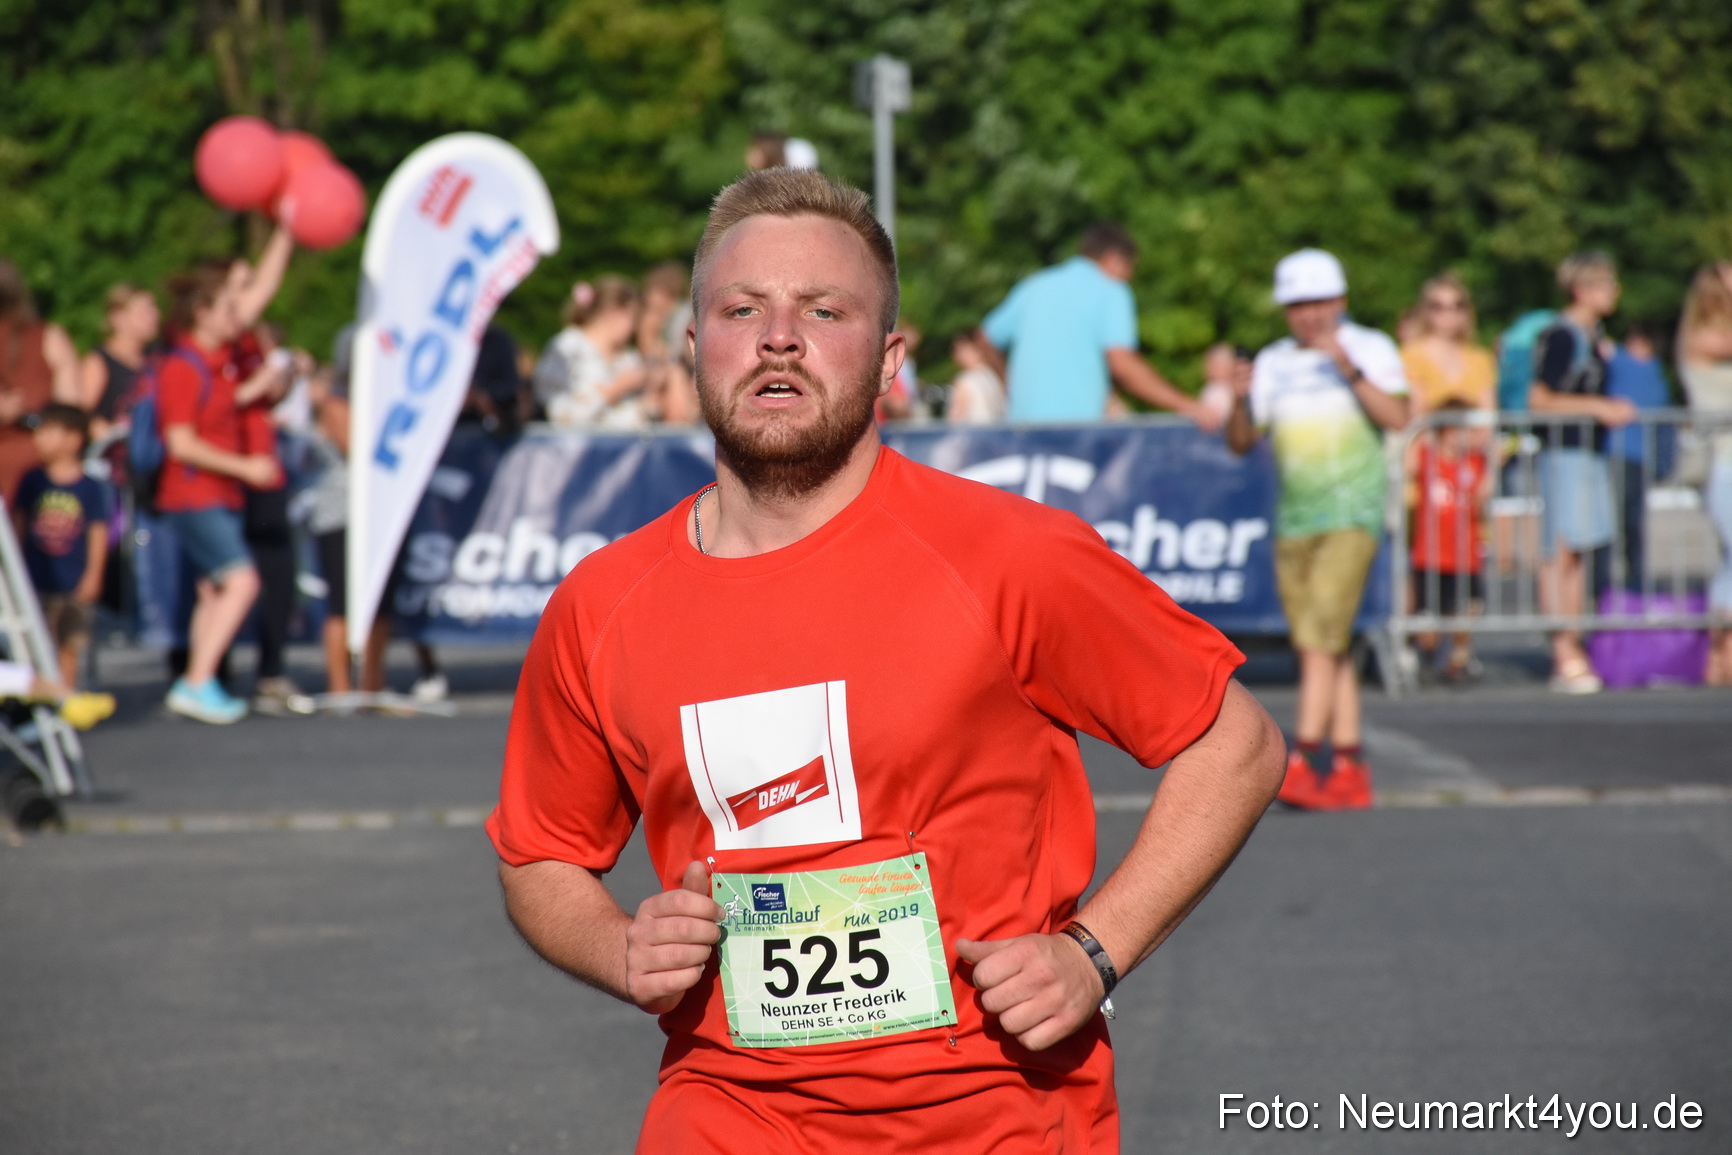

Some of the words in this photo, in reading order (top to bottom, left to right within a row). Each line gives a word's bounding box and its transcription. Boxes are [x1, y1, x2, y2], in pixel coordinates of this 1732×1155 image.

[407, 516, 628, 584] sche
[1094, 503, 1268, 570] cher
[758, 780, 800, 811] DEHN
[839, 872, 879, 883] Gesunde
[742, 905, 821, 924] firmenlauf
[844, 912, 871, 927] run
[878, 903, 919, 923] 2019
[763, 928, 890, 999] 525
[760, 1001, 828, 1018] Neunzer
[833, 989, 907, 1012] Frederik
[781, 1017, 815, 1031] DEHN
[817, 1016, 835, 1028] SE
[837, 1016, 845, 1024] +
[847, 1013, 865, 1024] Co
[867, 1009, 887, 1021] KG
